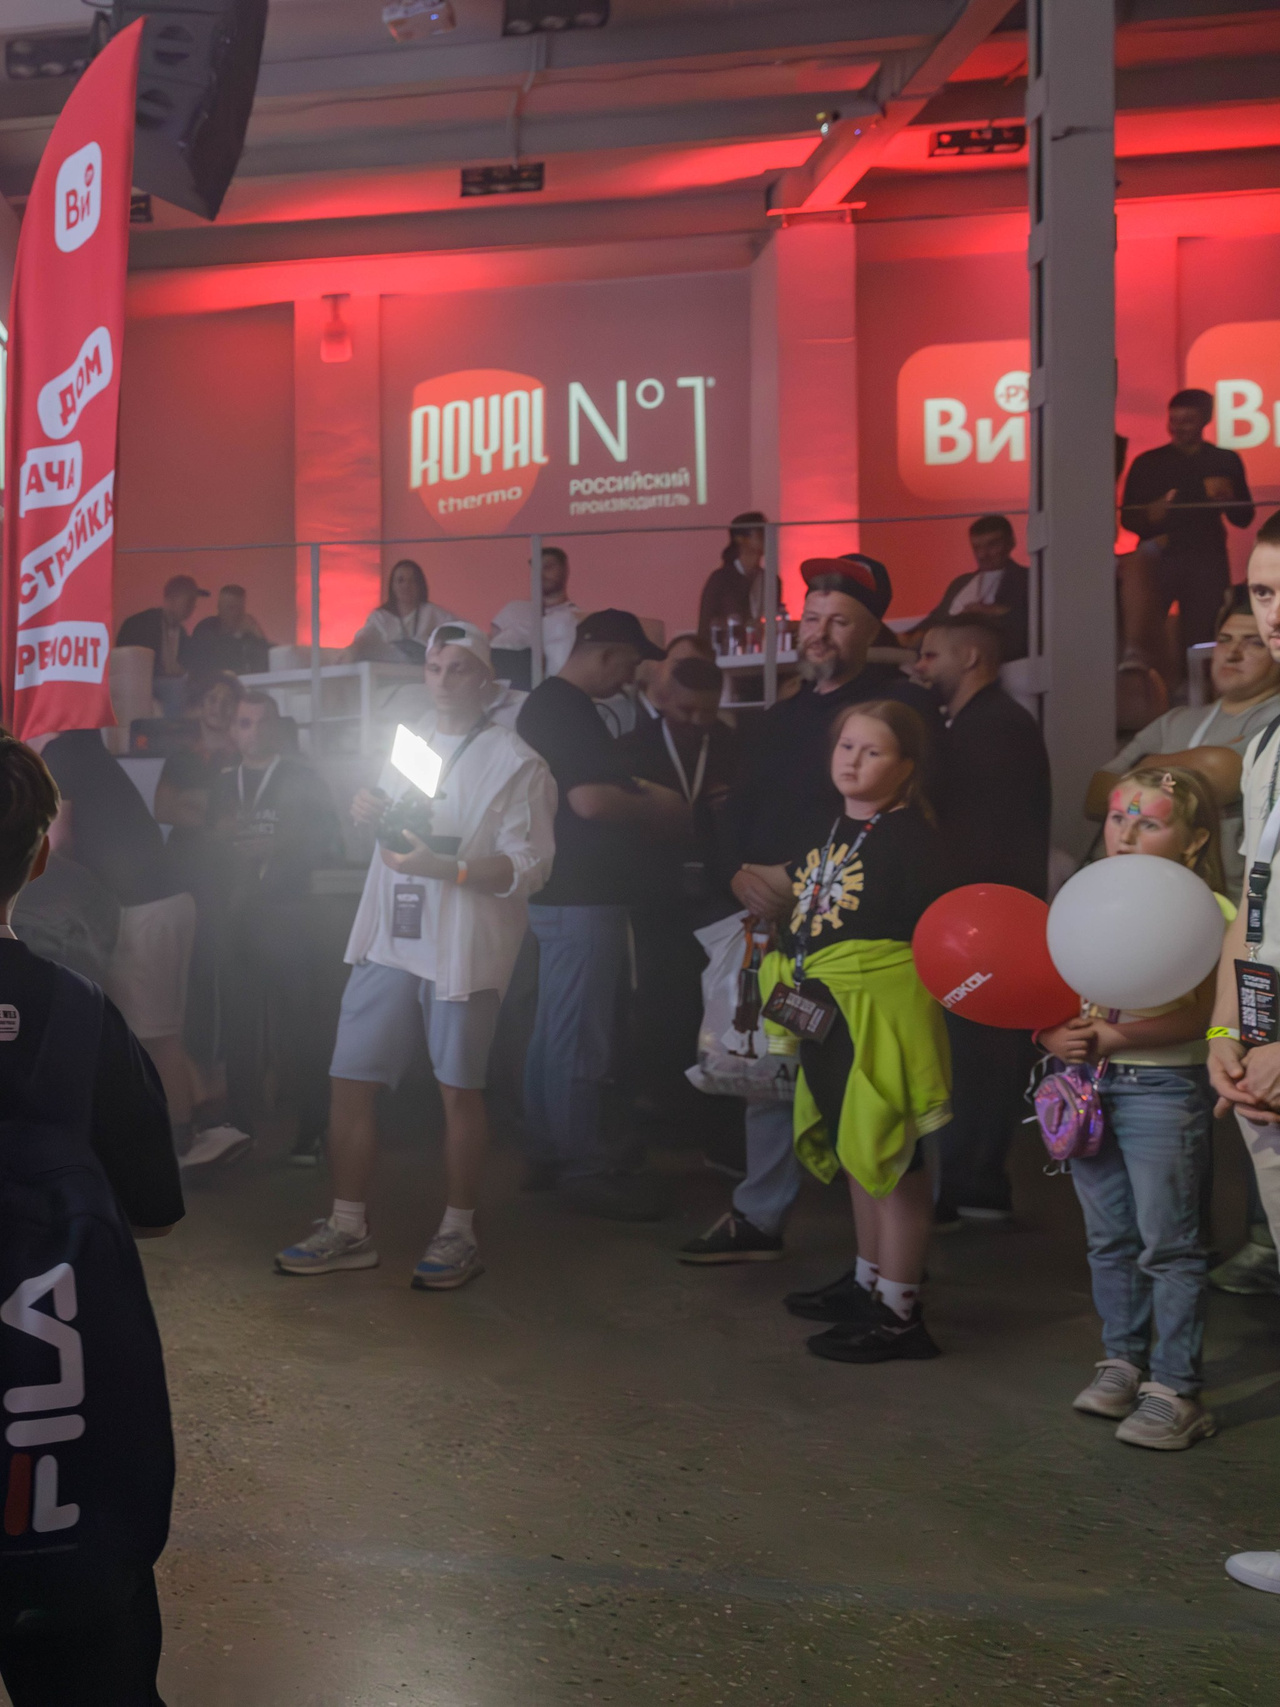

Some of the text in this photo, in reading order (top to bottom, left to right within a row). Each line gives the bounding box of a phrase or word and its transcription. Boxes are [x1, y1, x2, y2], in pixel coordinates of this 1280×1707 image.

[58, 344, 103, 427] ДОМ
[1215, 379, 1280, 452] В
[410, 387, 549, 489] ROYAL
[437, 486, 523, 515] thermo
[569, 467, 690, 497] РОССИЙСКИЙ
[0, 1262, 86, 1537] FILA
